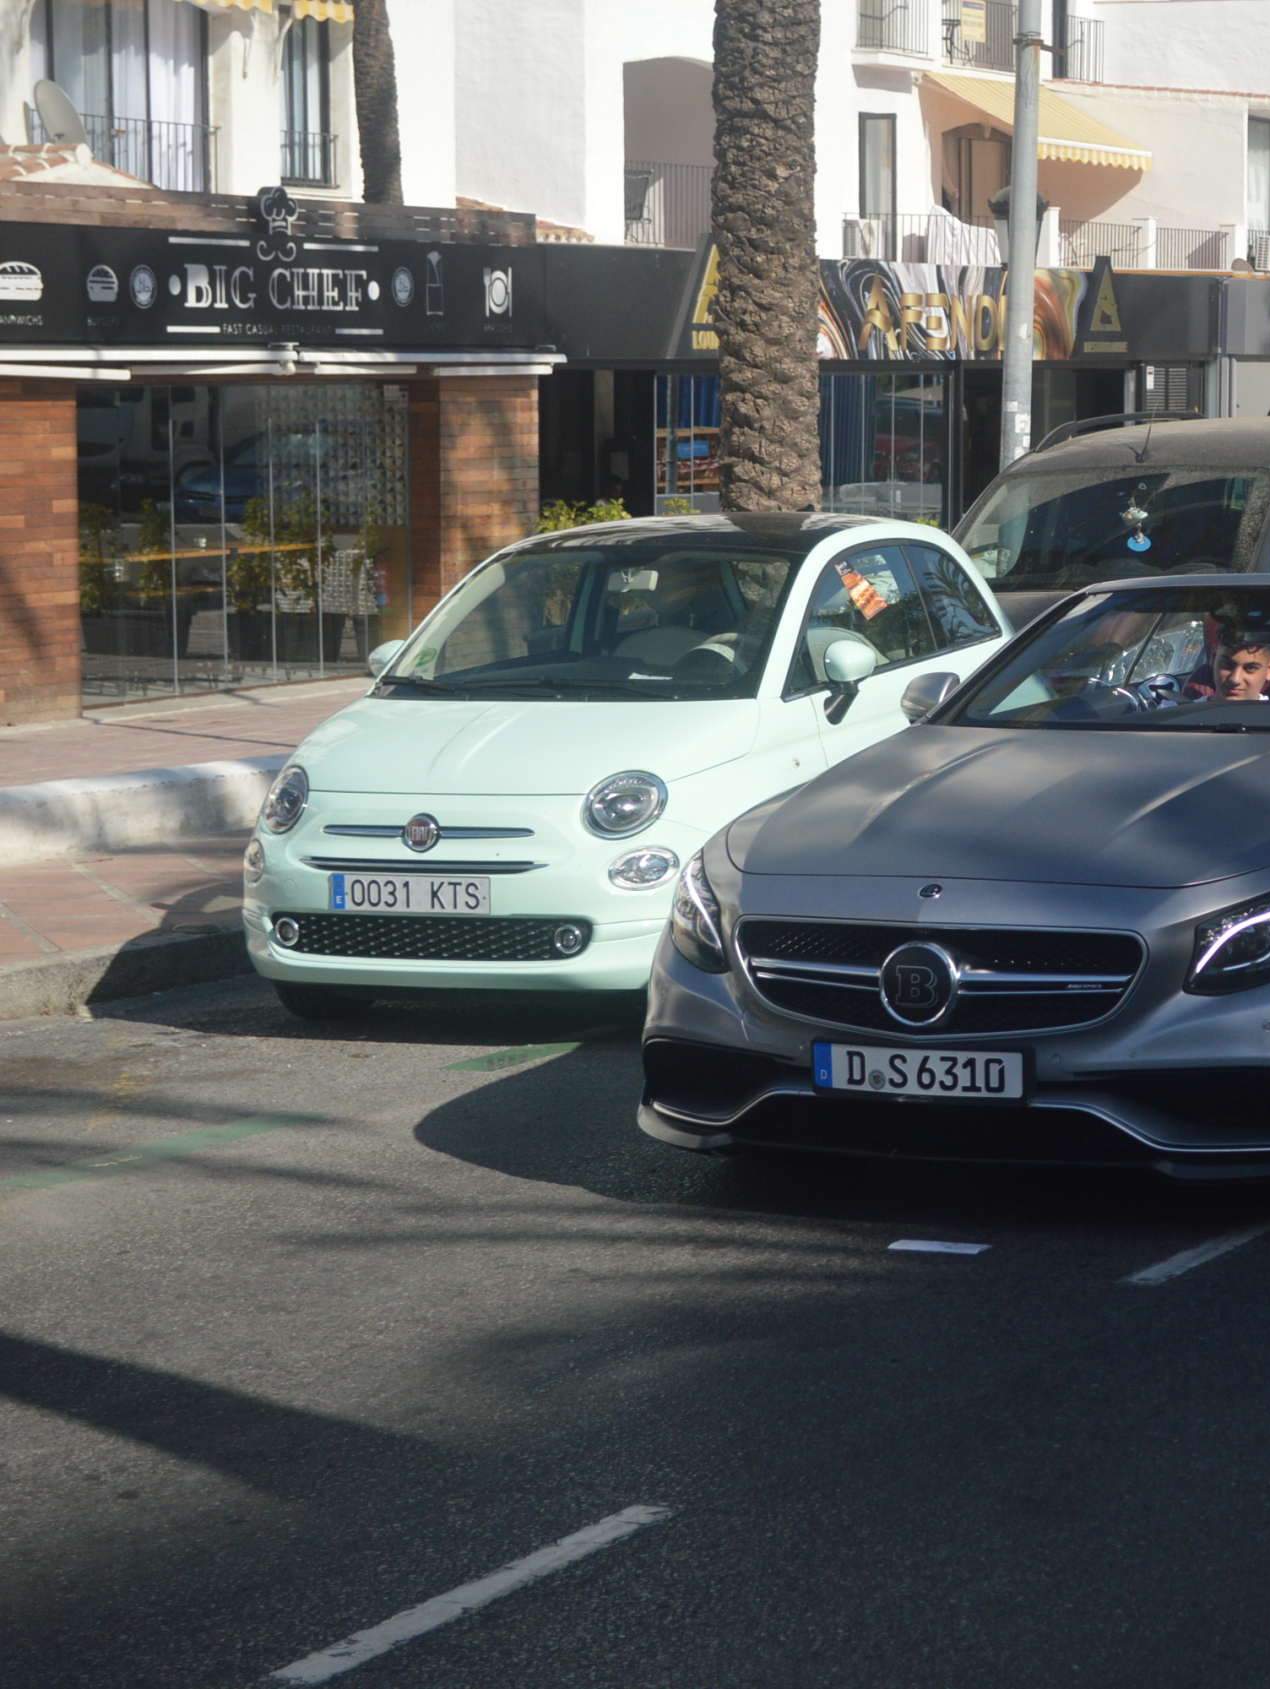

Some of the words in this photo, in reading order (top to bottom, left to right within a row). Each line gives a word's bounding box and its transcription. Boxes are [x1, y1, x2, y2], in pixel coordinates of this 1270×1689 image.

[184, 264, 257, 309] BIG
[268, 268, 367, 311] CHEF
[223, 323, 243, 335] FAST
[411, 826, 428, 841] FIAT
[351, 879, 410, 909] 0031
[431, 881, 480, 910] KTS
